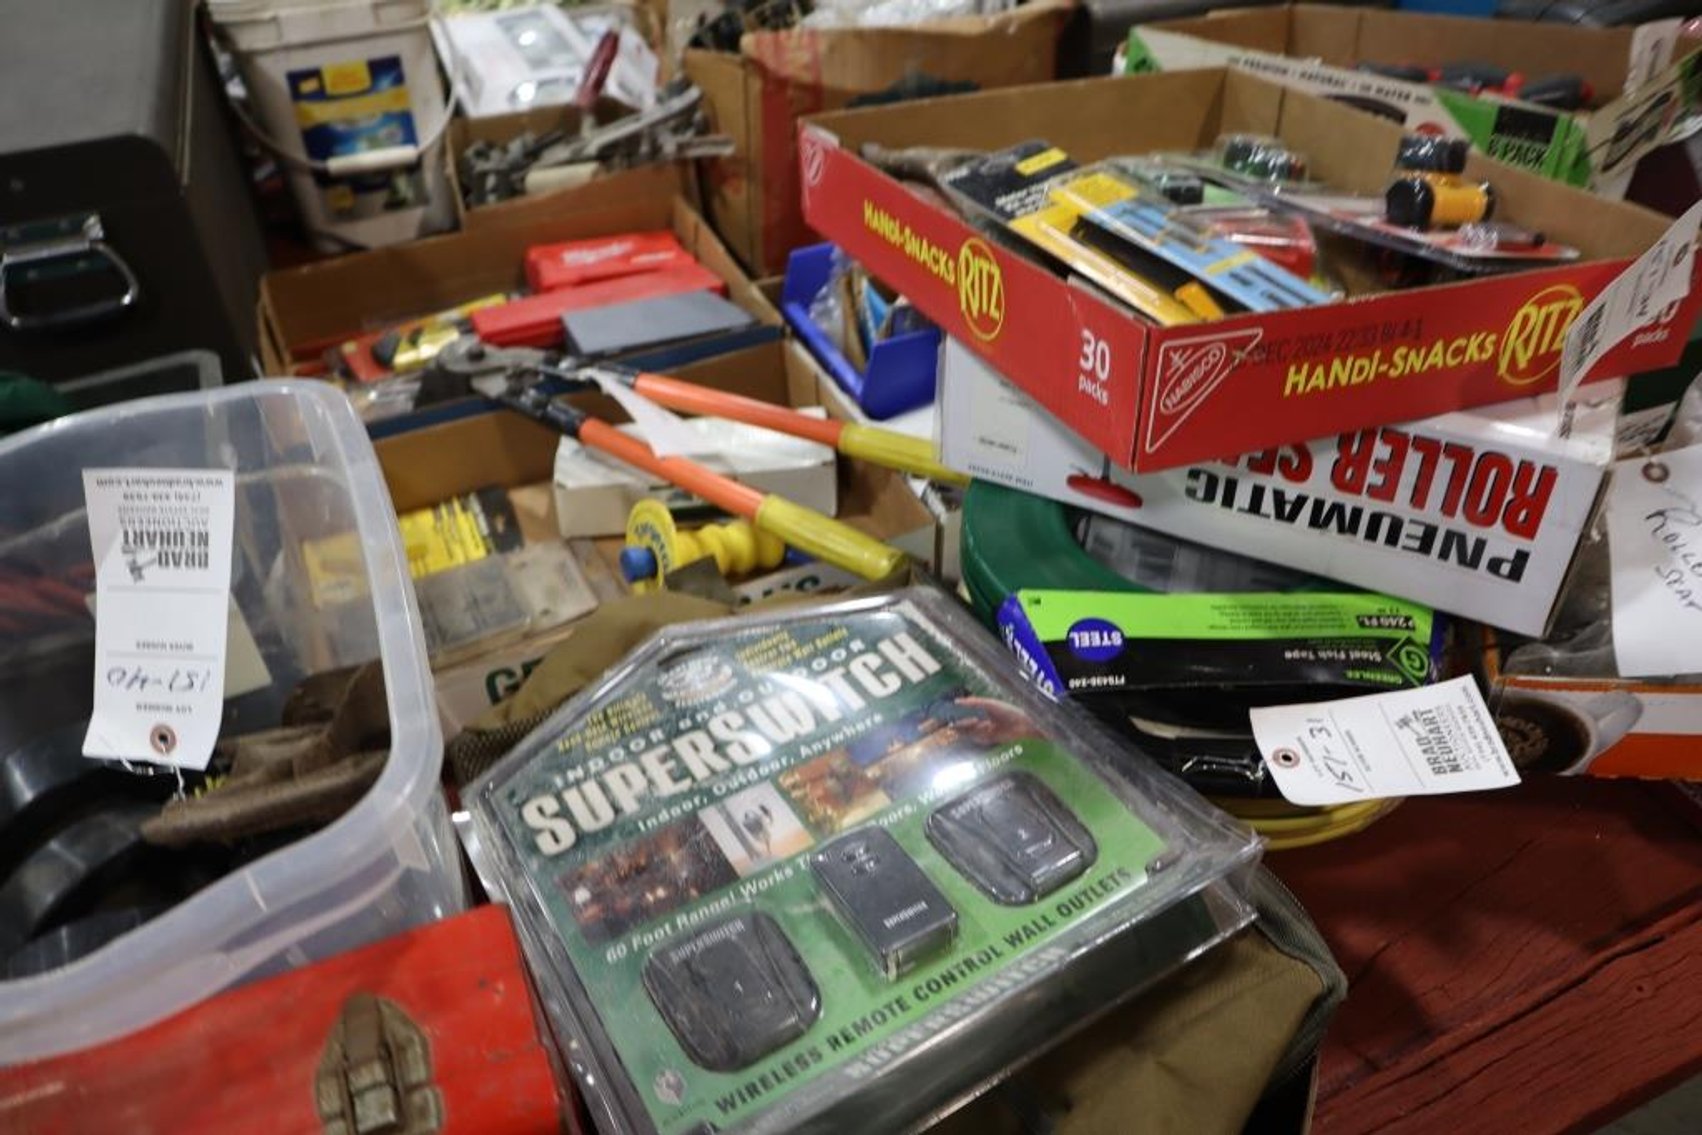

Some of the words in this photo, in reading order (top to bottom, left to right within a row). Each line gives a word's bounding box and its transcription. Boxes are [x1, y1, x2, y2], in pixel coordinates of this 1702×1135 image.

[863, 199, 956, 286] HANDI-SNACKS
[959, 244, 1001, 321] RITZ
[1079, 328, 1111, 381] 30
[1283, 332, 1498, 397] HANDI-SNACKS
[1496, 296, 1585, 377] RITZ
[1078, 375, 1109, 405] packs
[1165, 347, 1222, 410] NABISCO
[1330, 427, 1559, 541] ROLLER
[123, 531, 209, 547] NEUHART
[158, 551, 209, 568] BRAD
[1184, 467, 1532, 583] PNEUMATIC
[1069, 630, 1124, 649] STEEL
[553, 726, 665, 788] INDOOR
[678, 699, 728, 731] and
[738, 637, 866, 702] OUDOOR
[1421, 708, 1464, 774] NEUHART
[637, 786, 708, 833] Indoor,
[712, 755, 795, 797] Outdoor,
[800, 713, 883, 757] Anywhere
[1415, 736, 1449, 776] BRAD
[631, 922, 673, 952] Foot
[739, 865, 796, 904] Works
[714, 1048, 823, 1115] WIRELESS
[826, 993, 911, 1052] REMOTE
[912, 941, 1005, 1001] CONTROL
[1003, 909, 1056, 950] WALL
[1057, 865, 1132, 918] OUTLETS
